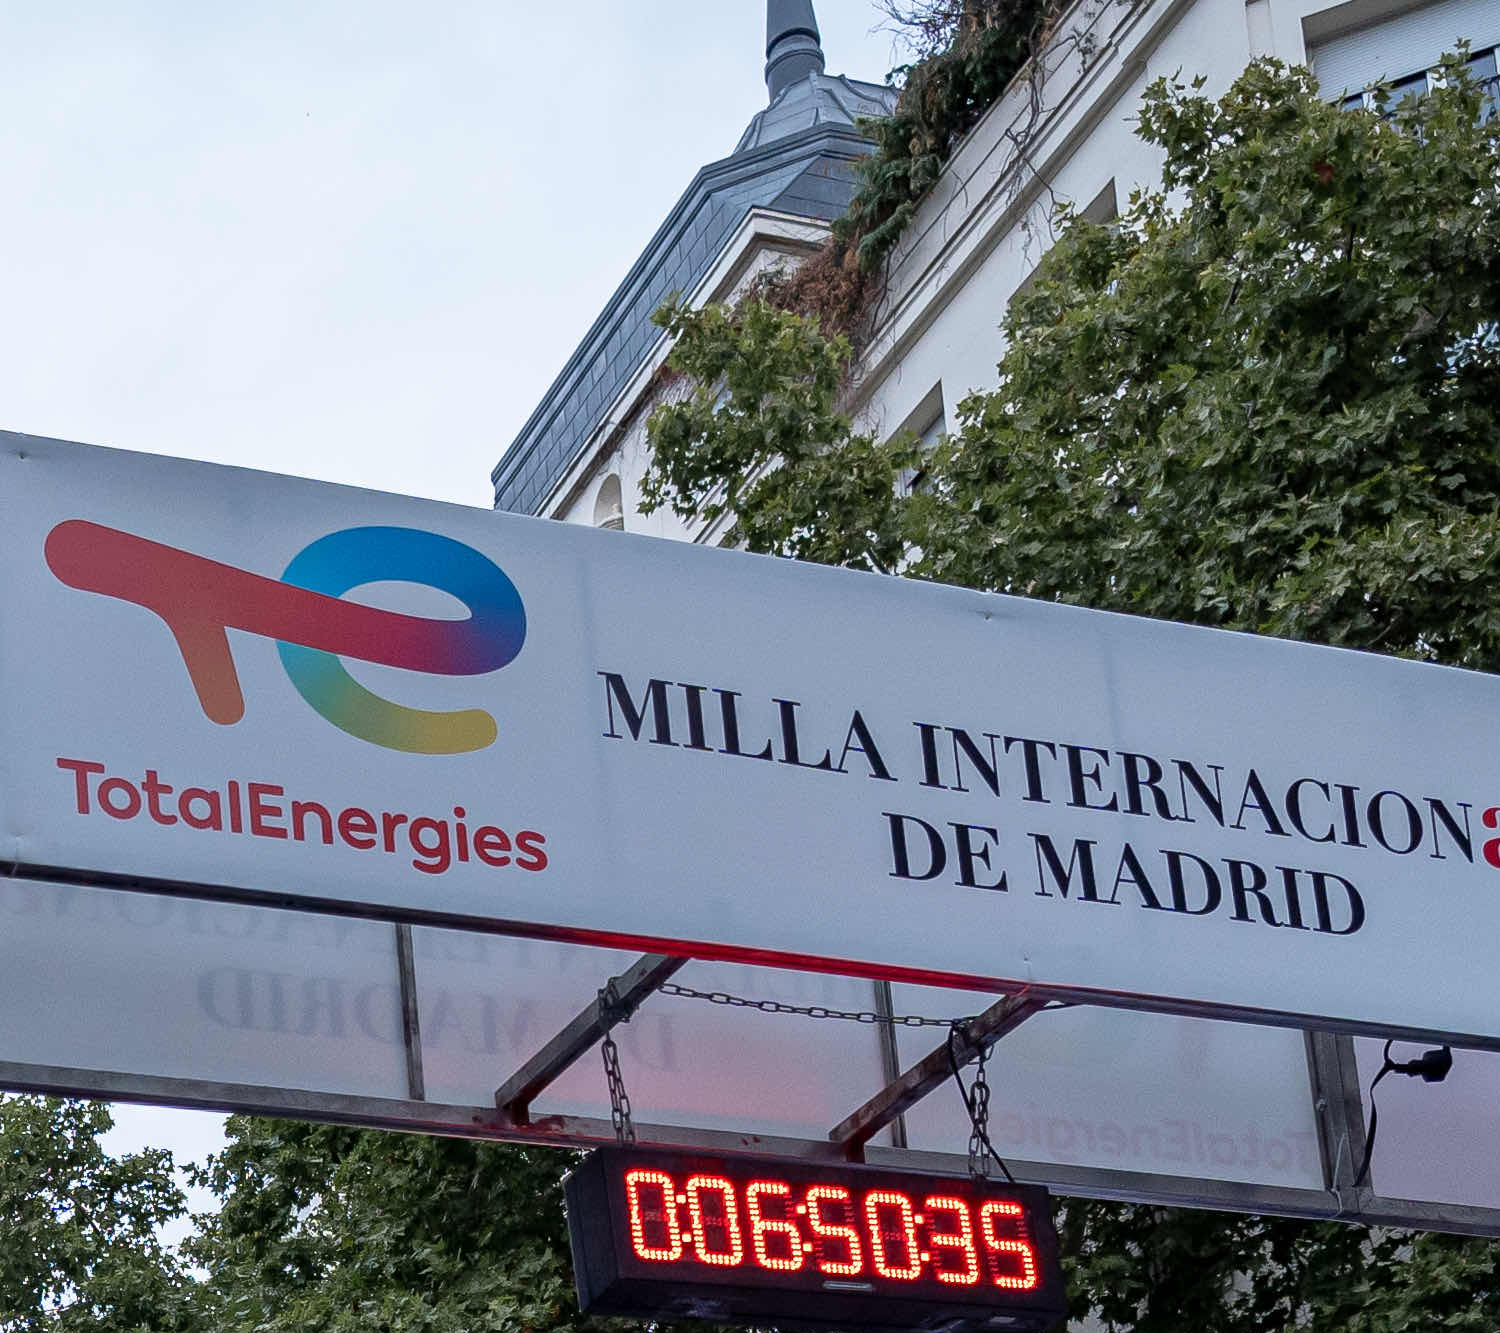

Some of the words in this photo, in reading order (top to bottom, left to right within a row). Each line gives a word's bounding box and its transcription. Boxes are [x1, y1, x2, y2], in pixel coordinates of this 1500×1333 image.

[599, 670, 900, 783] MILLA
[56, 757, 550, 875] TotalEnergies
[887, 812, 1011, 891] DE
[1032, 833, 1367, 938] MADRID
